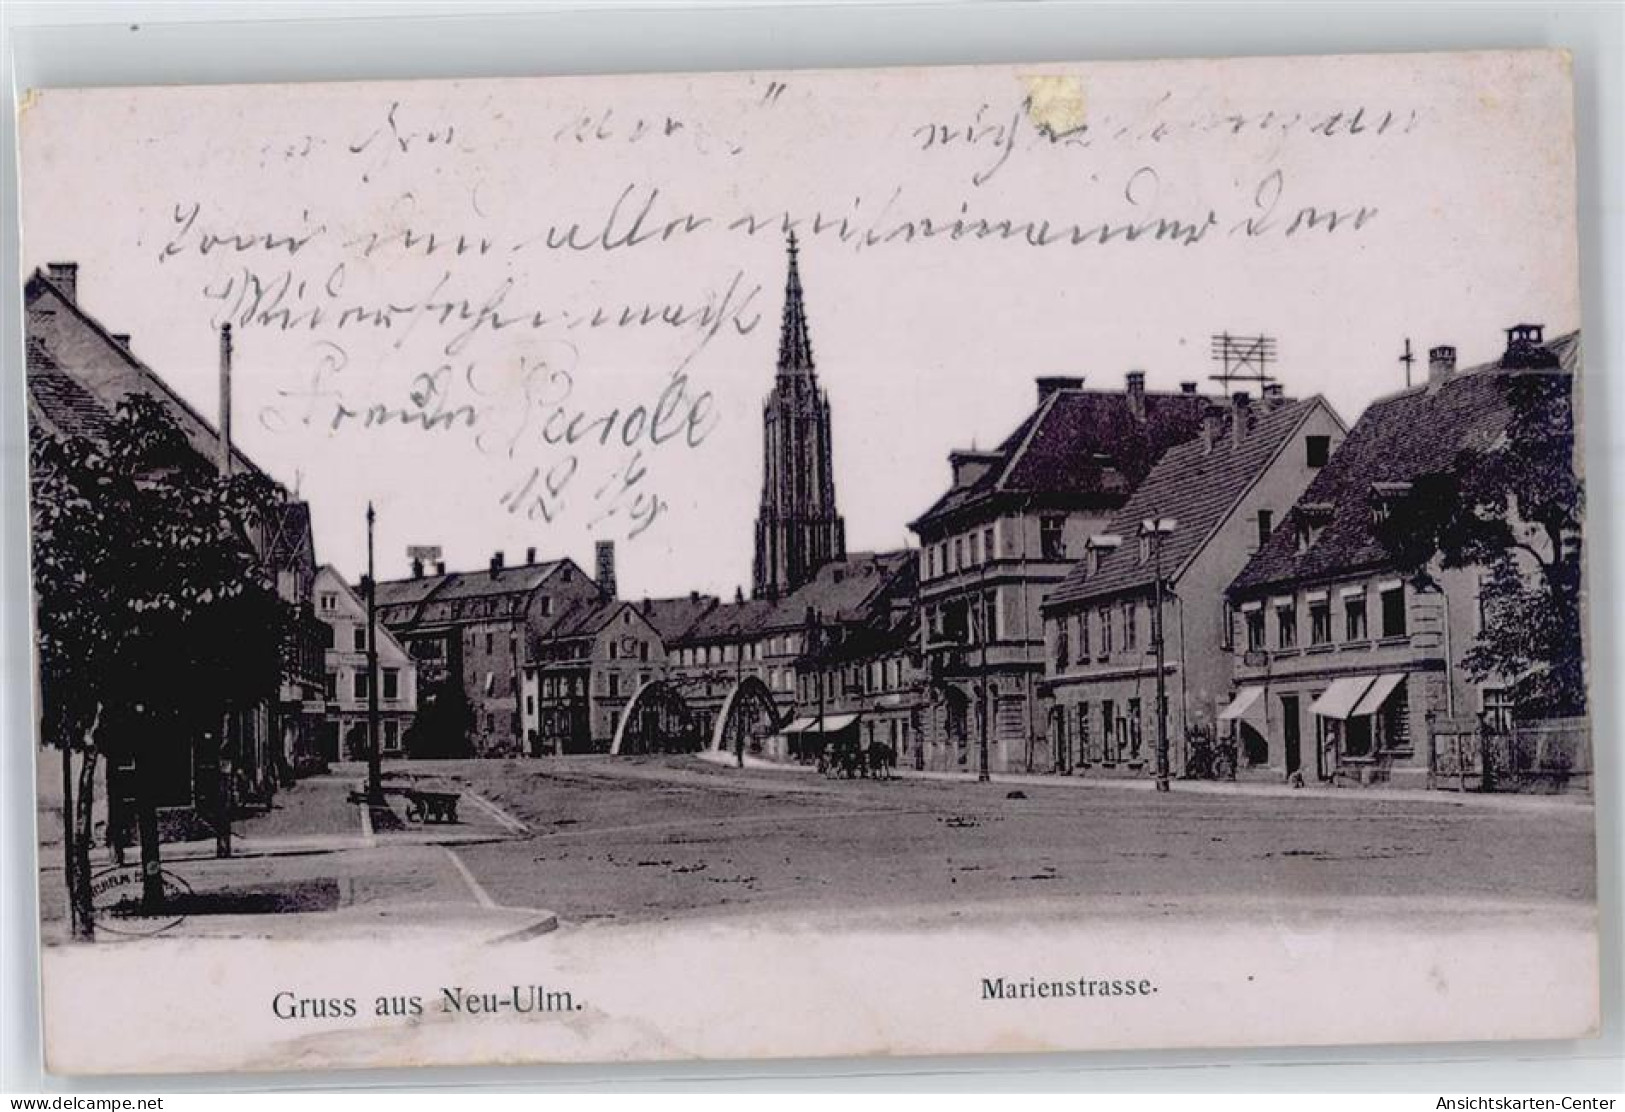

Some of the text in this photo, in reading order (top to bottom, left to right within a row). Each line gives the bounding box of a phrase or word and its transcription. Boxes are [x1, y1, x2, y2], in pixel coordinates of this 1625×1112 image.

[272, 984, 583, 1019] Gruss aus Neu-Ulm.
[981, 976, 1159, 1001] Marienstrasse.
